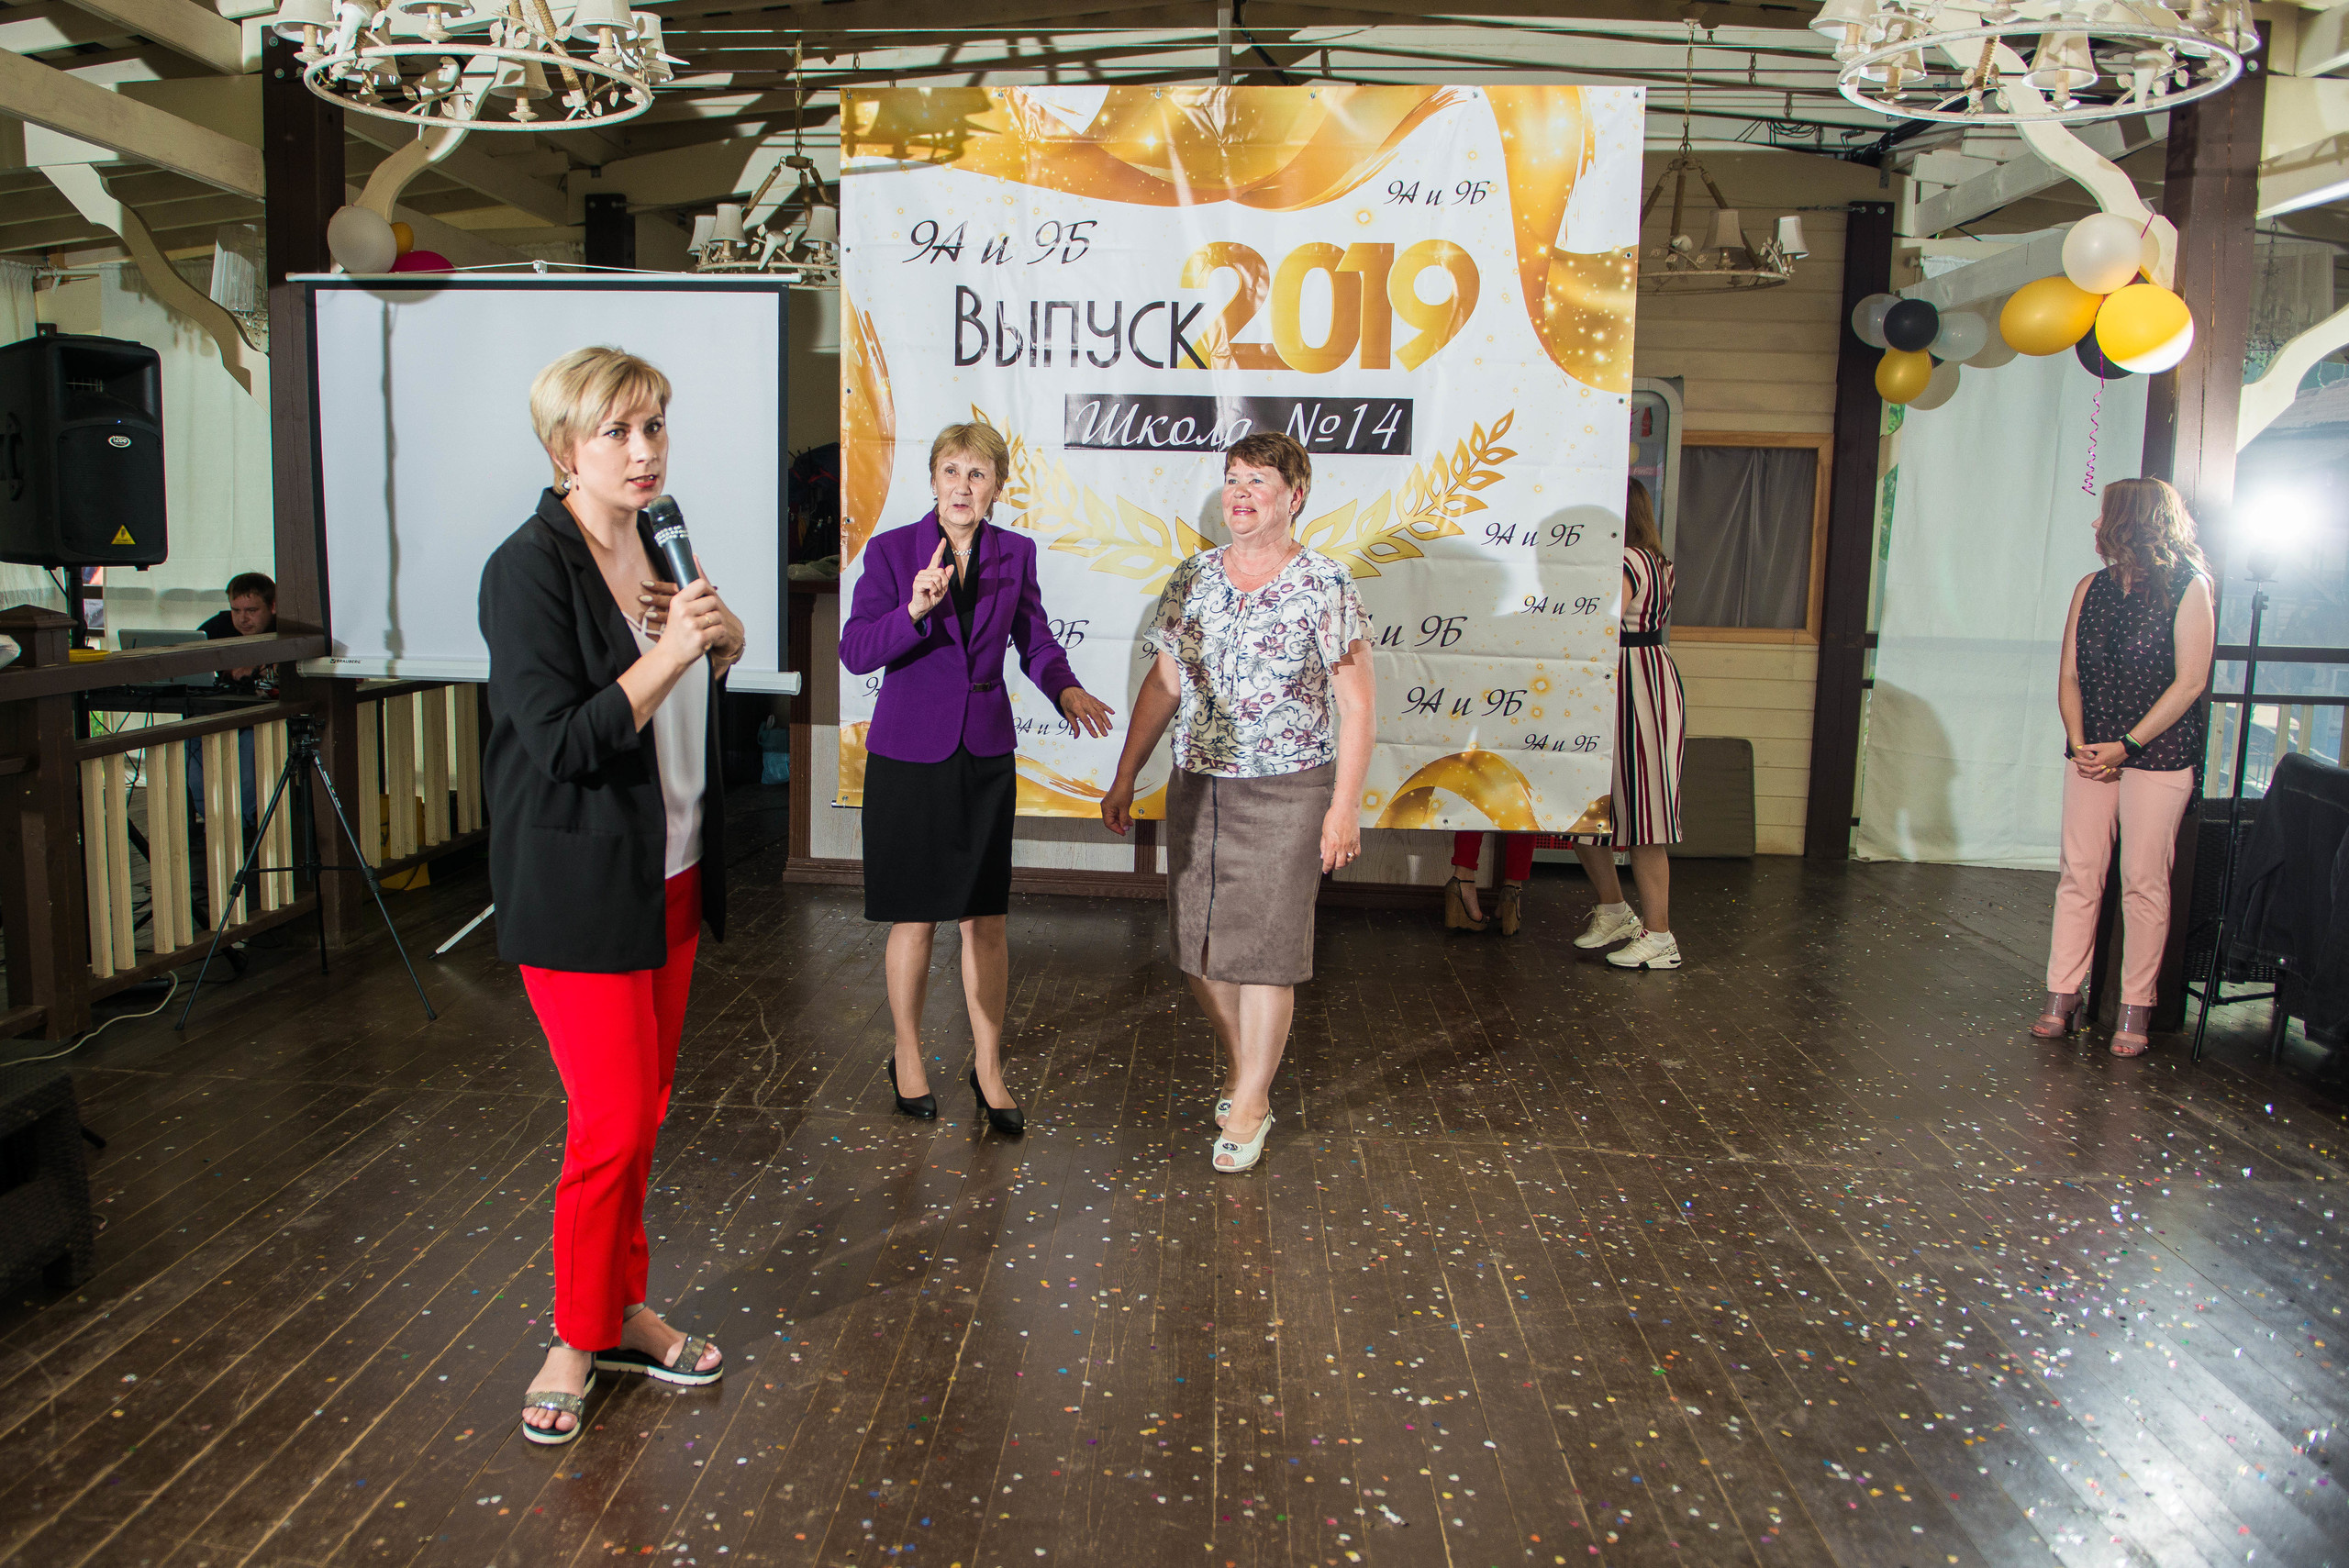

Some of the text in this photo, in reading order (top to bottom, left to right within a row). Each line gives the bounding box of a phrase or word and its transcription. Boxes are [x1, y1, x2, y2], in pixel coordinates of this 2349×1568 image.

[1383, 180, 1491, 206] 9А и 9Б
[902, 219, 1098, 266] 9А и 9Б
[954, 239, 1481, 374] Выпуск 2019
[1074, 400, 1253, 453] Школа
[1480, 522, 1585, 547] 9А и 9Б
[1520, 595, 1600, 615] 9А и 9Б
[1380, 615, 1468, 648] и 9Б
[863, 676, 880, 697] 9
[1401, 686, 1528, 717] 9А и 9Б
[1037, 724, 1051, 735] и
[1520, 733, 1600, 752] 9А и 9Б
